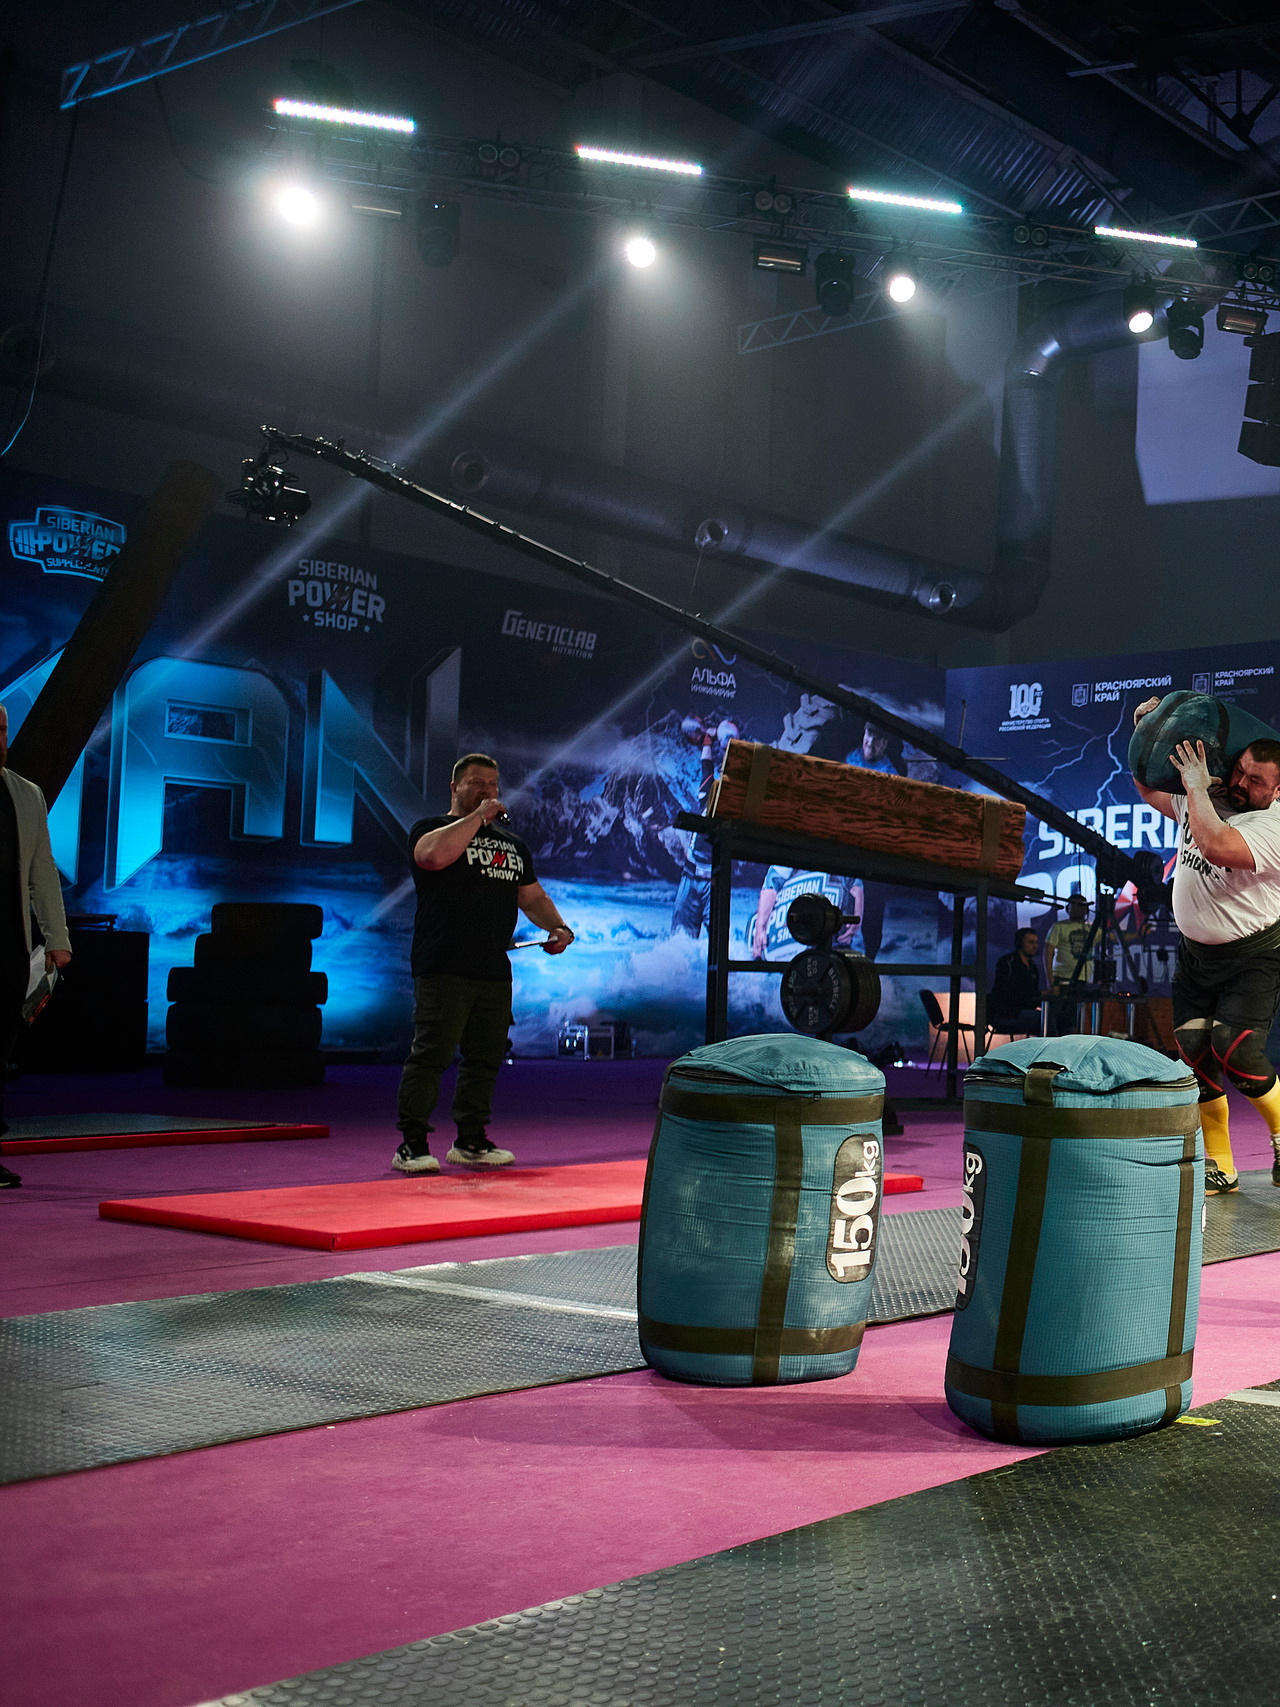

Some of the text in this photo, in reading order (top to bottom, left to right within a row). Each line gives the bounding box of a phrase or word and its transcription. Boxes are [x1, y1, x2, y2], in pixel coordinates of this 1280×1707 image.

[46, 516, 116, 543] SIBERIAN
[299, 559, 378, 591] SIBERIAN
[288, 579, 386, 623] POWER
[314, 611, 359, 632] SHOP
[501, 609, 598, 651] GENETICLAB
[691, 666, 737, 689] АЛЬФА
[1095, 674, 1172, 692] КРАСНОЯРСКИЙ
[1214, 665, 1275, 679] КРАСНОЯРСКИЙ
[1214, 678, 1235, 687] КРАЙ
[1094, 690, 1120, 703] КРАЙ
[466, 847, 524, 875] POWER
[1181, 849, 1213, 877] SHOW
[486, 867, 515, 882] SHOW
